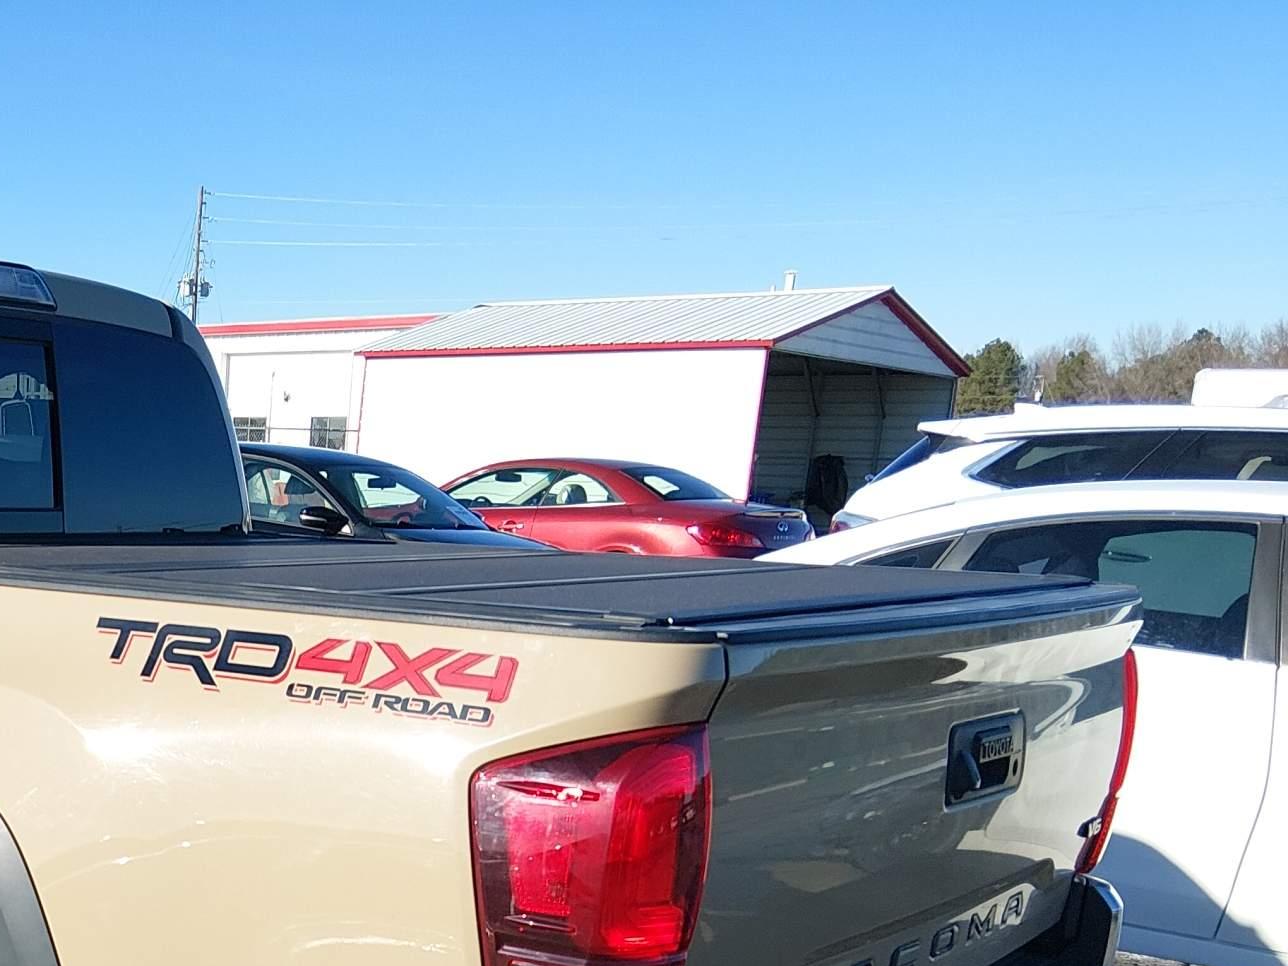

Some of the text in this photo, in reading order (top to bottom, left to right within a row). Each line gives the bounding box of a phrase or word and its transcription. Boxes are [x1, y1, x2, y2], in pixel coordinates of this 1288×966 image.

[96, 617, 519, 704] TRD 4X4
[286, 683, 494, 727] OFF ROAD
[983, 737, 1015, 759] TOYOTA
[1088, 817, 1102, 838] V6
